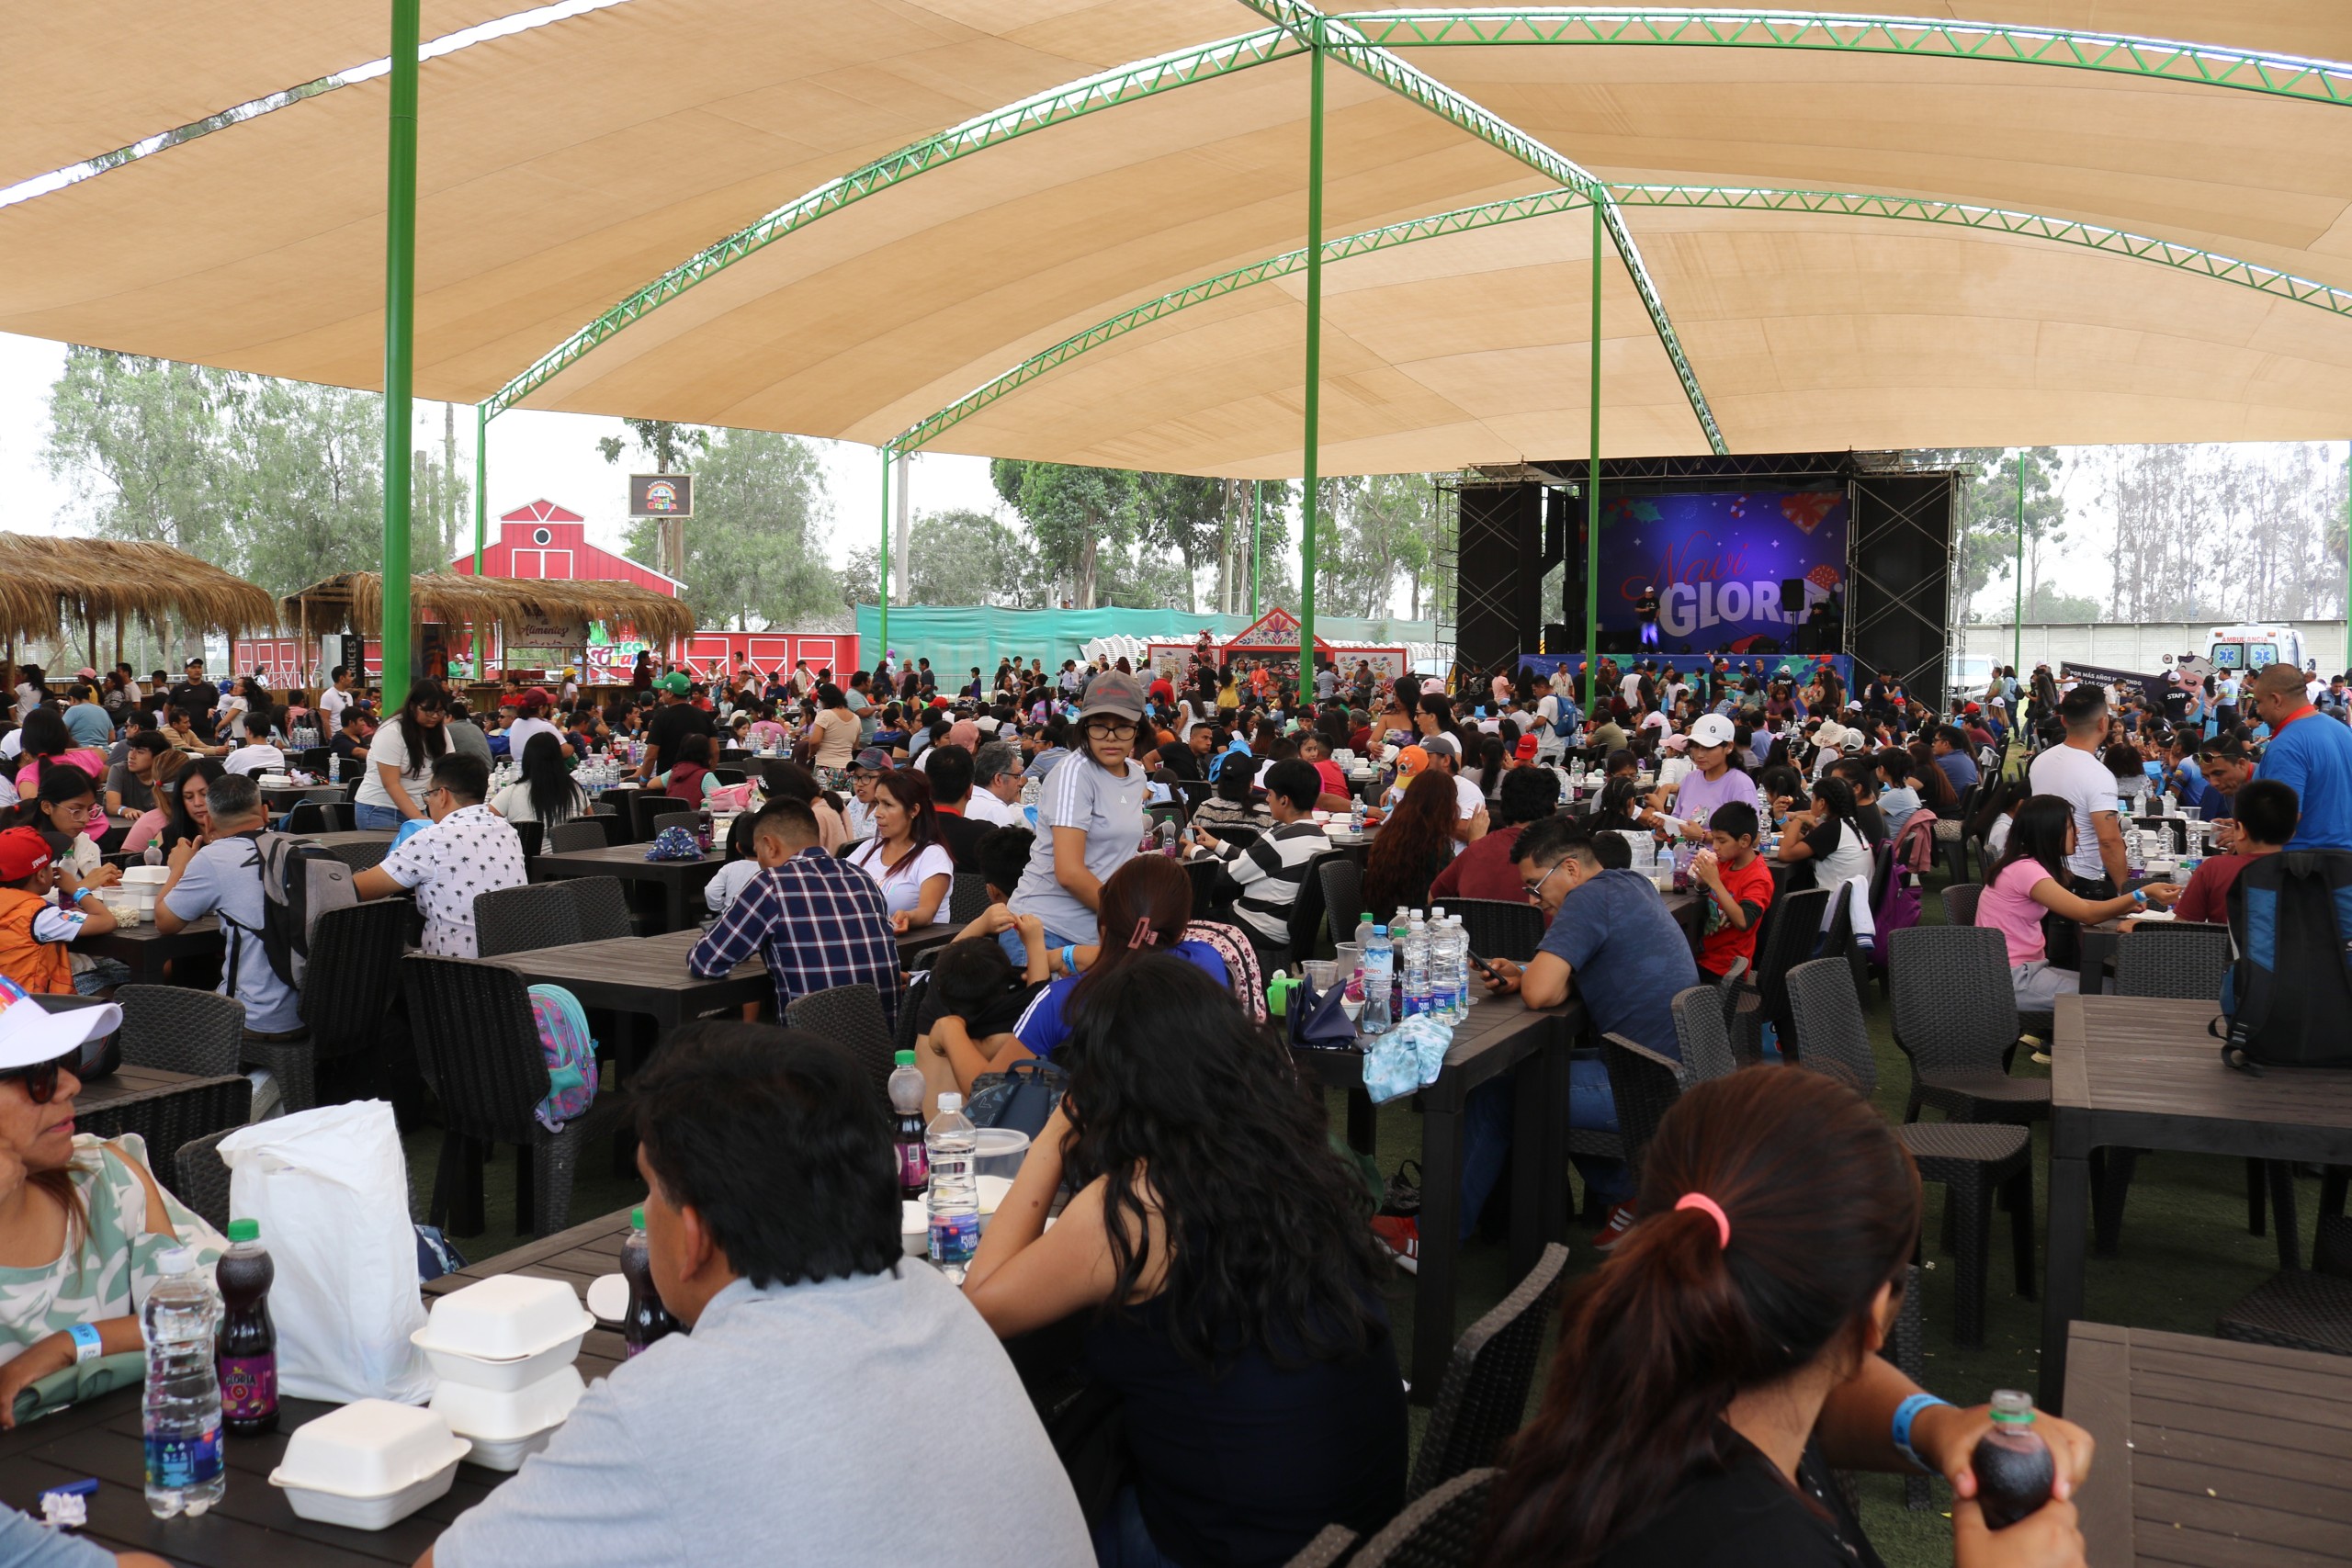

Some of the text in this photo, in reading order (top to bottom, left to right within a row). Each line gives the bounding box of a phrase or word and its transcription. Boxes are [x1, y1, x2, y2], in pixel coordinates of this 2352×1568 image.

[1621, 530, 1749, 601] Navi
[521, 625, 569, 637] Alimentos
[2096, 673, 2112, 682] AÑOS
[225, 1374, 257, 1386] GLORIA
